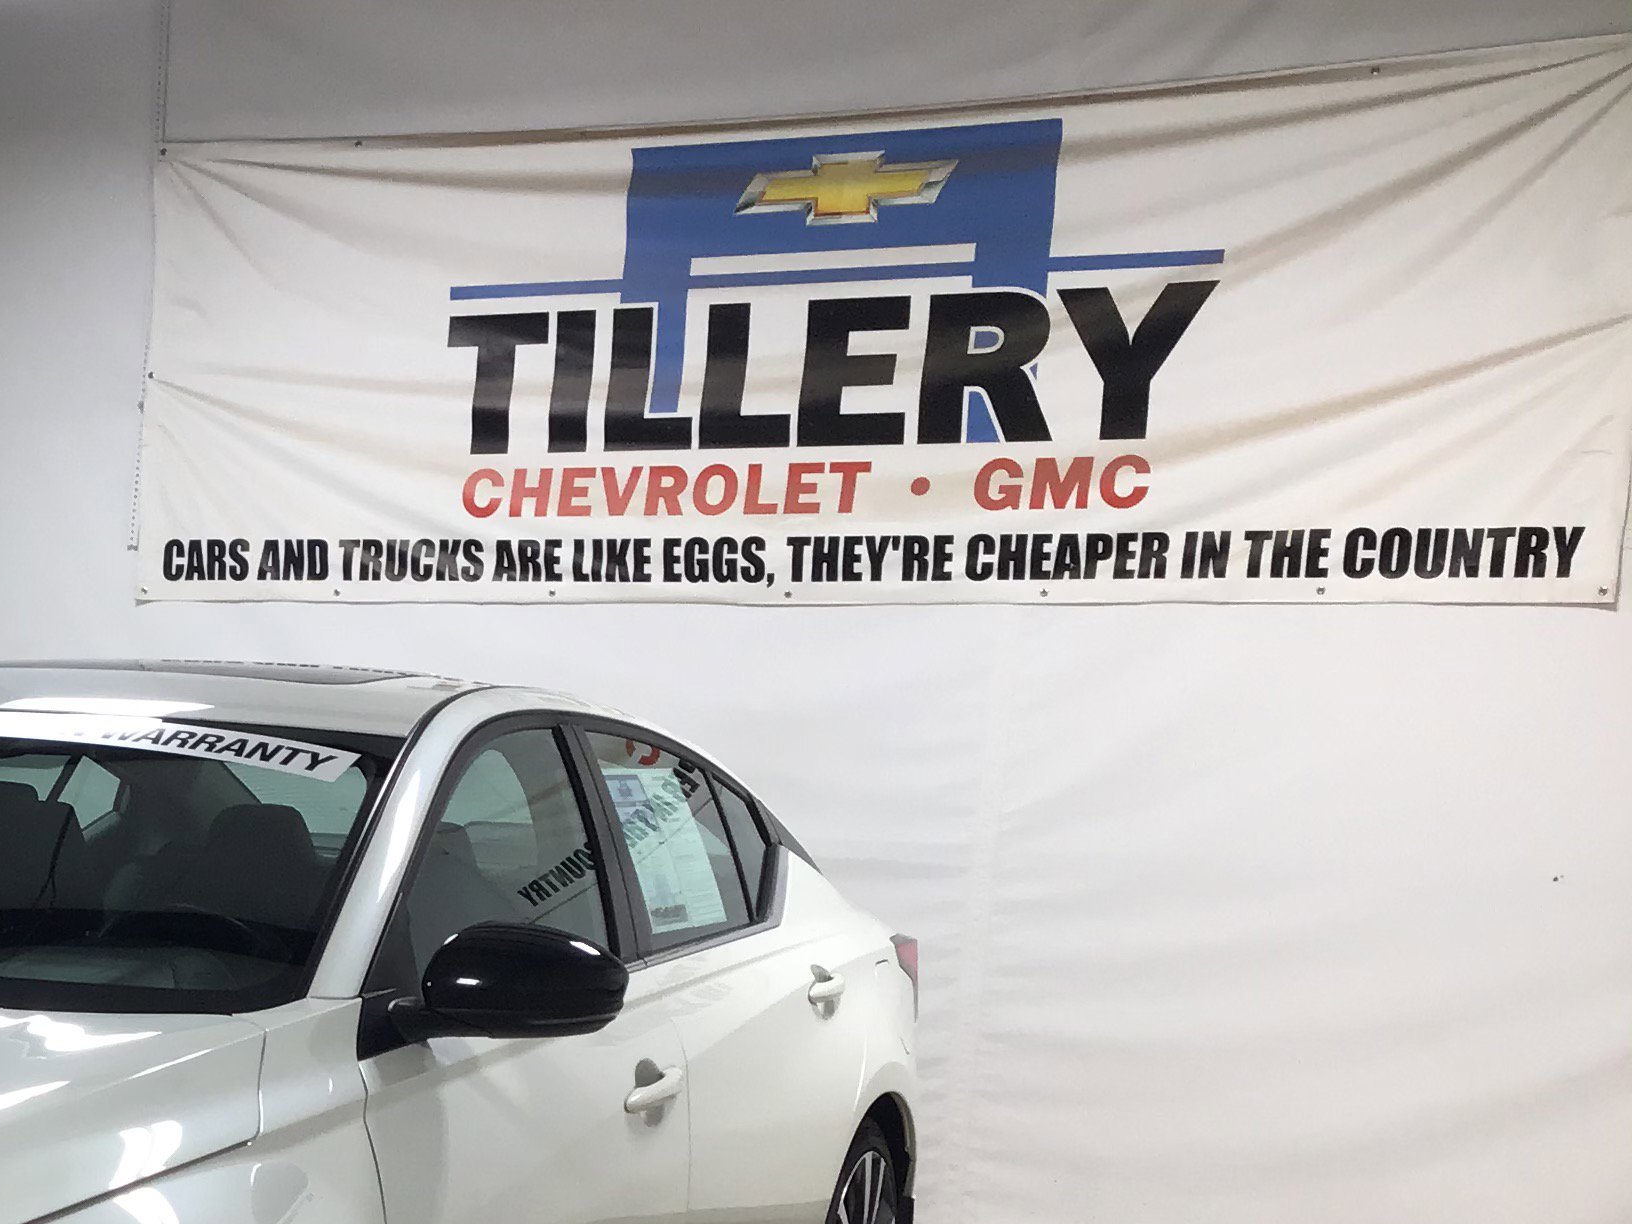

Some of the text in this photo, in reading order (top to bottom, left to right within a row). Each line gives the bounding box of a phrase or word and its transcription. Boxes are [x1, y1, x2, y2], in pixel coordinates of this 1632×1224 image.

[447, 279, 1221, 455] TILLERY
[461, 454, 1152, 519] CHEVROLET GMC
[162, 526, 1586, 588] CARS AND TRUCKS ARE LIKE EGGS, THEY'RE CHEAPER IN THE COUNTRY
